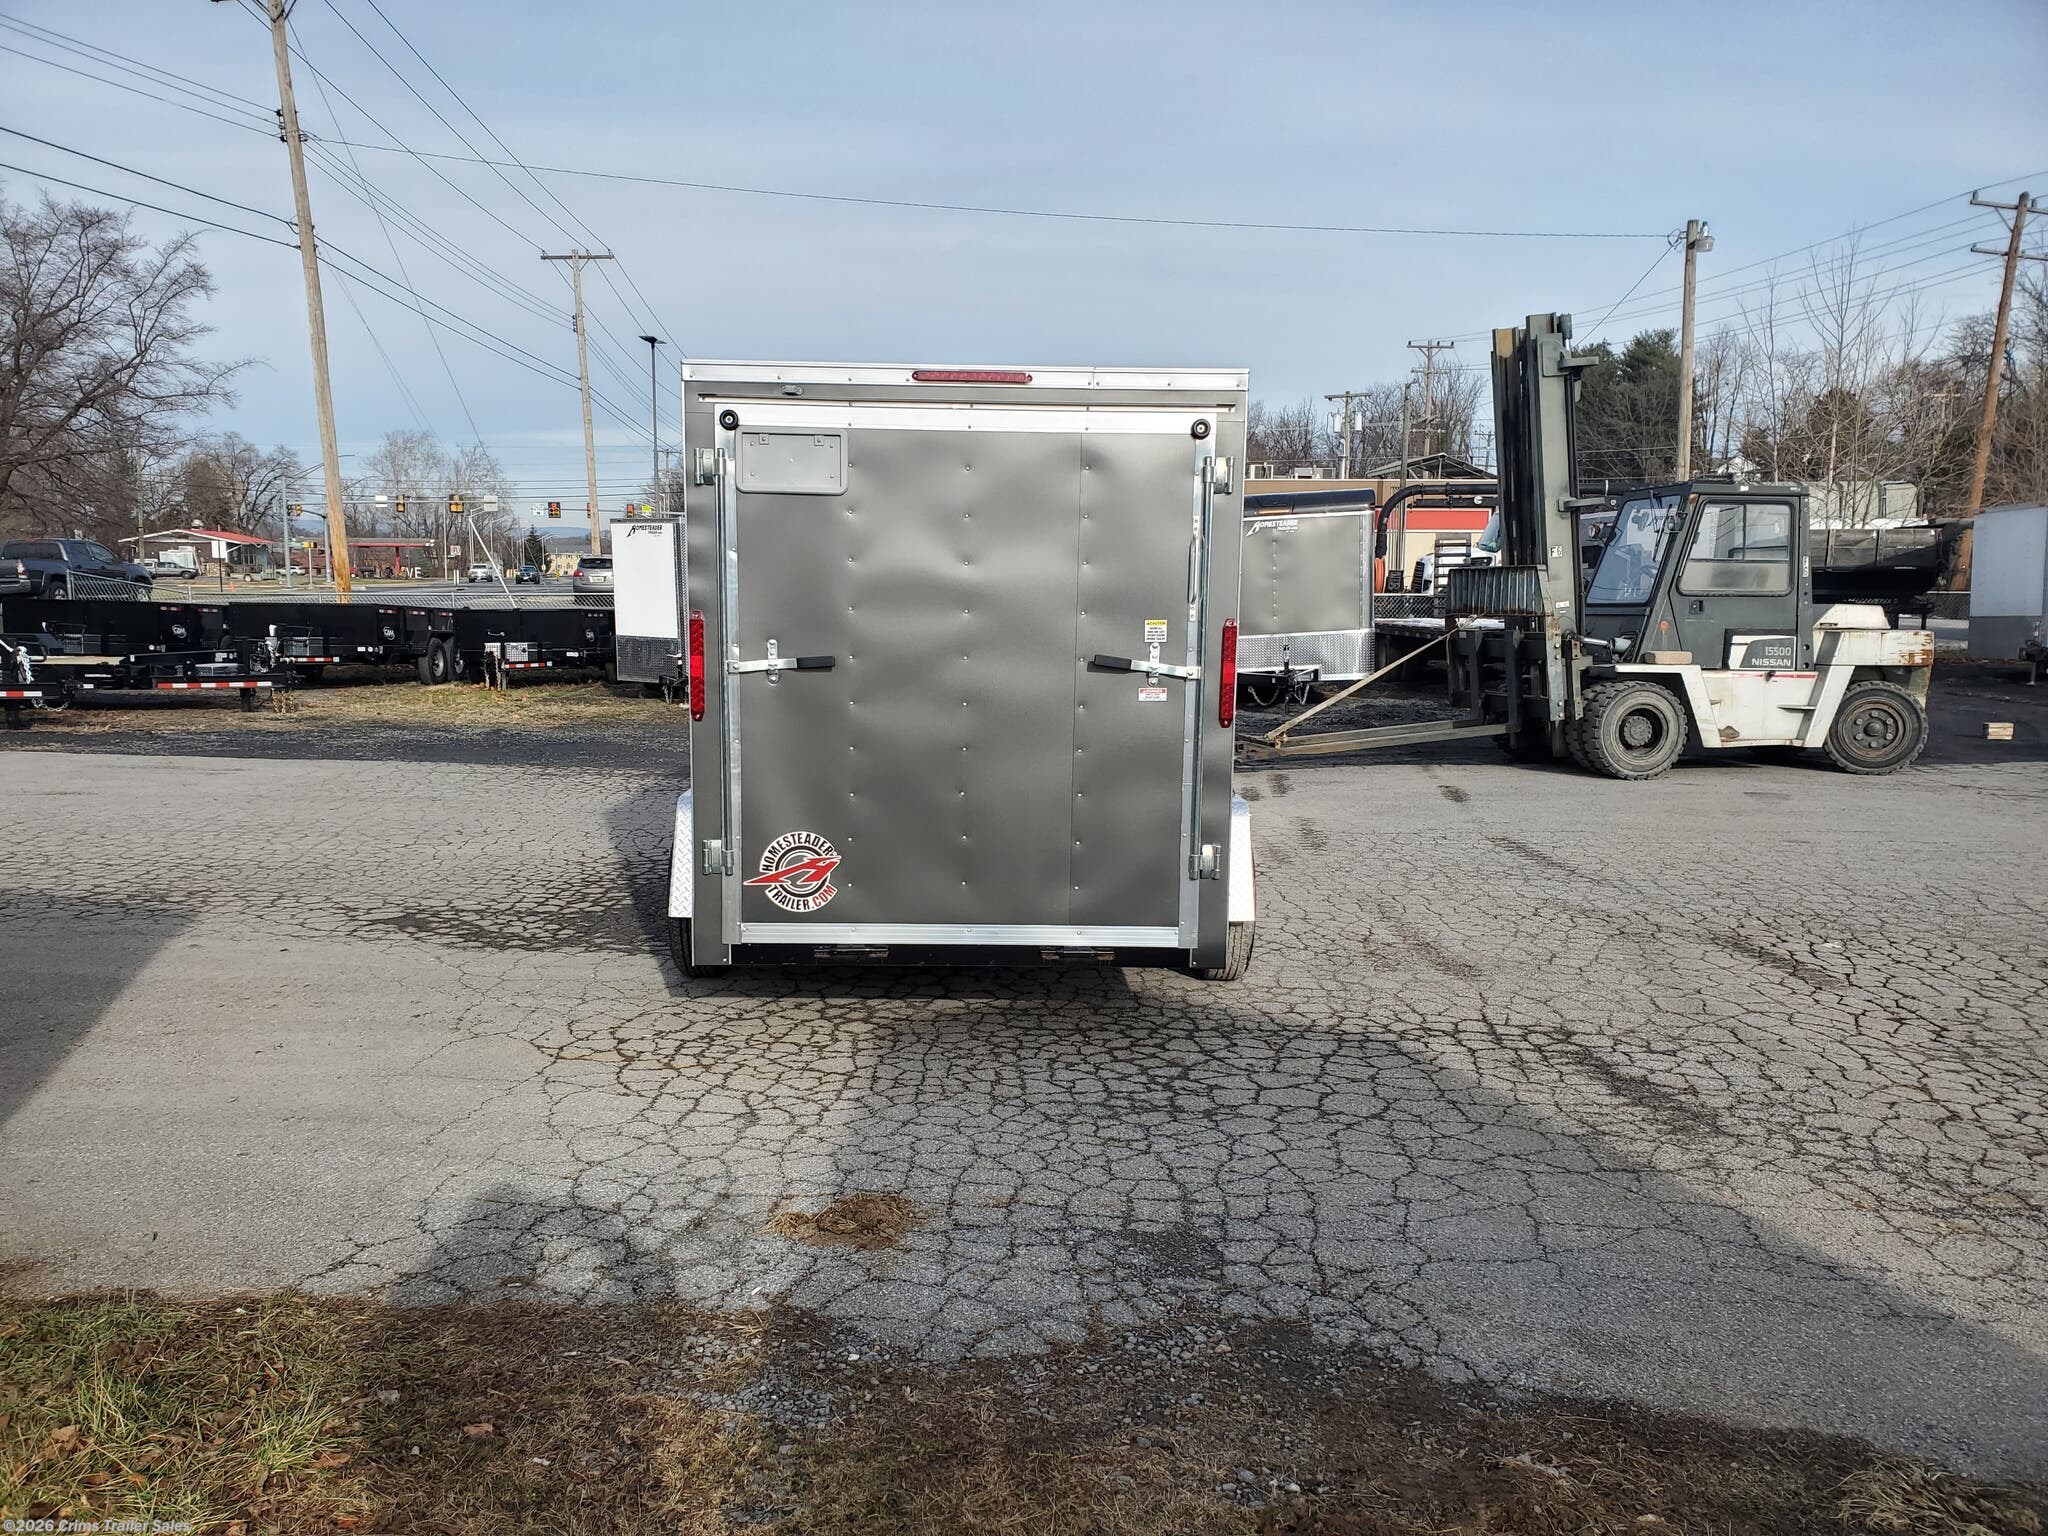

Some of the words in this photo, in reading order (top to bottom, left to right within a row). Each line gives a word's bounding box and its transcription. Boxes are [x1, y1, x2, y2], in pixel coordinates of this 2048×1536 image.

[1550, 546, 1562, 557] F6
[1765, 646, 1792, 656] 15500
[1751, 658, 1792, 667] NISSAN
[761, 832, 835, 872] HOMESTEADER
[767, 884, 837, 911] TRAILER.COM
